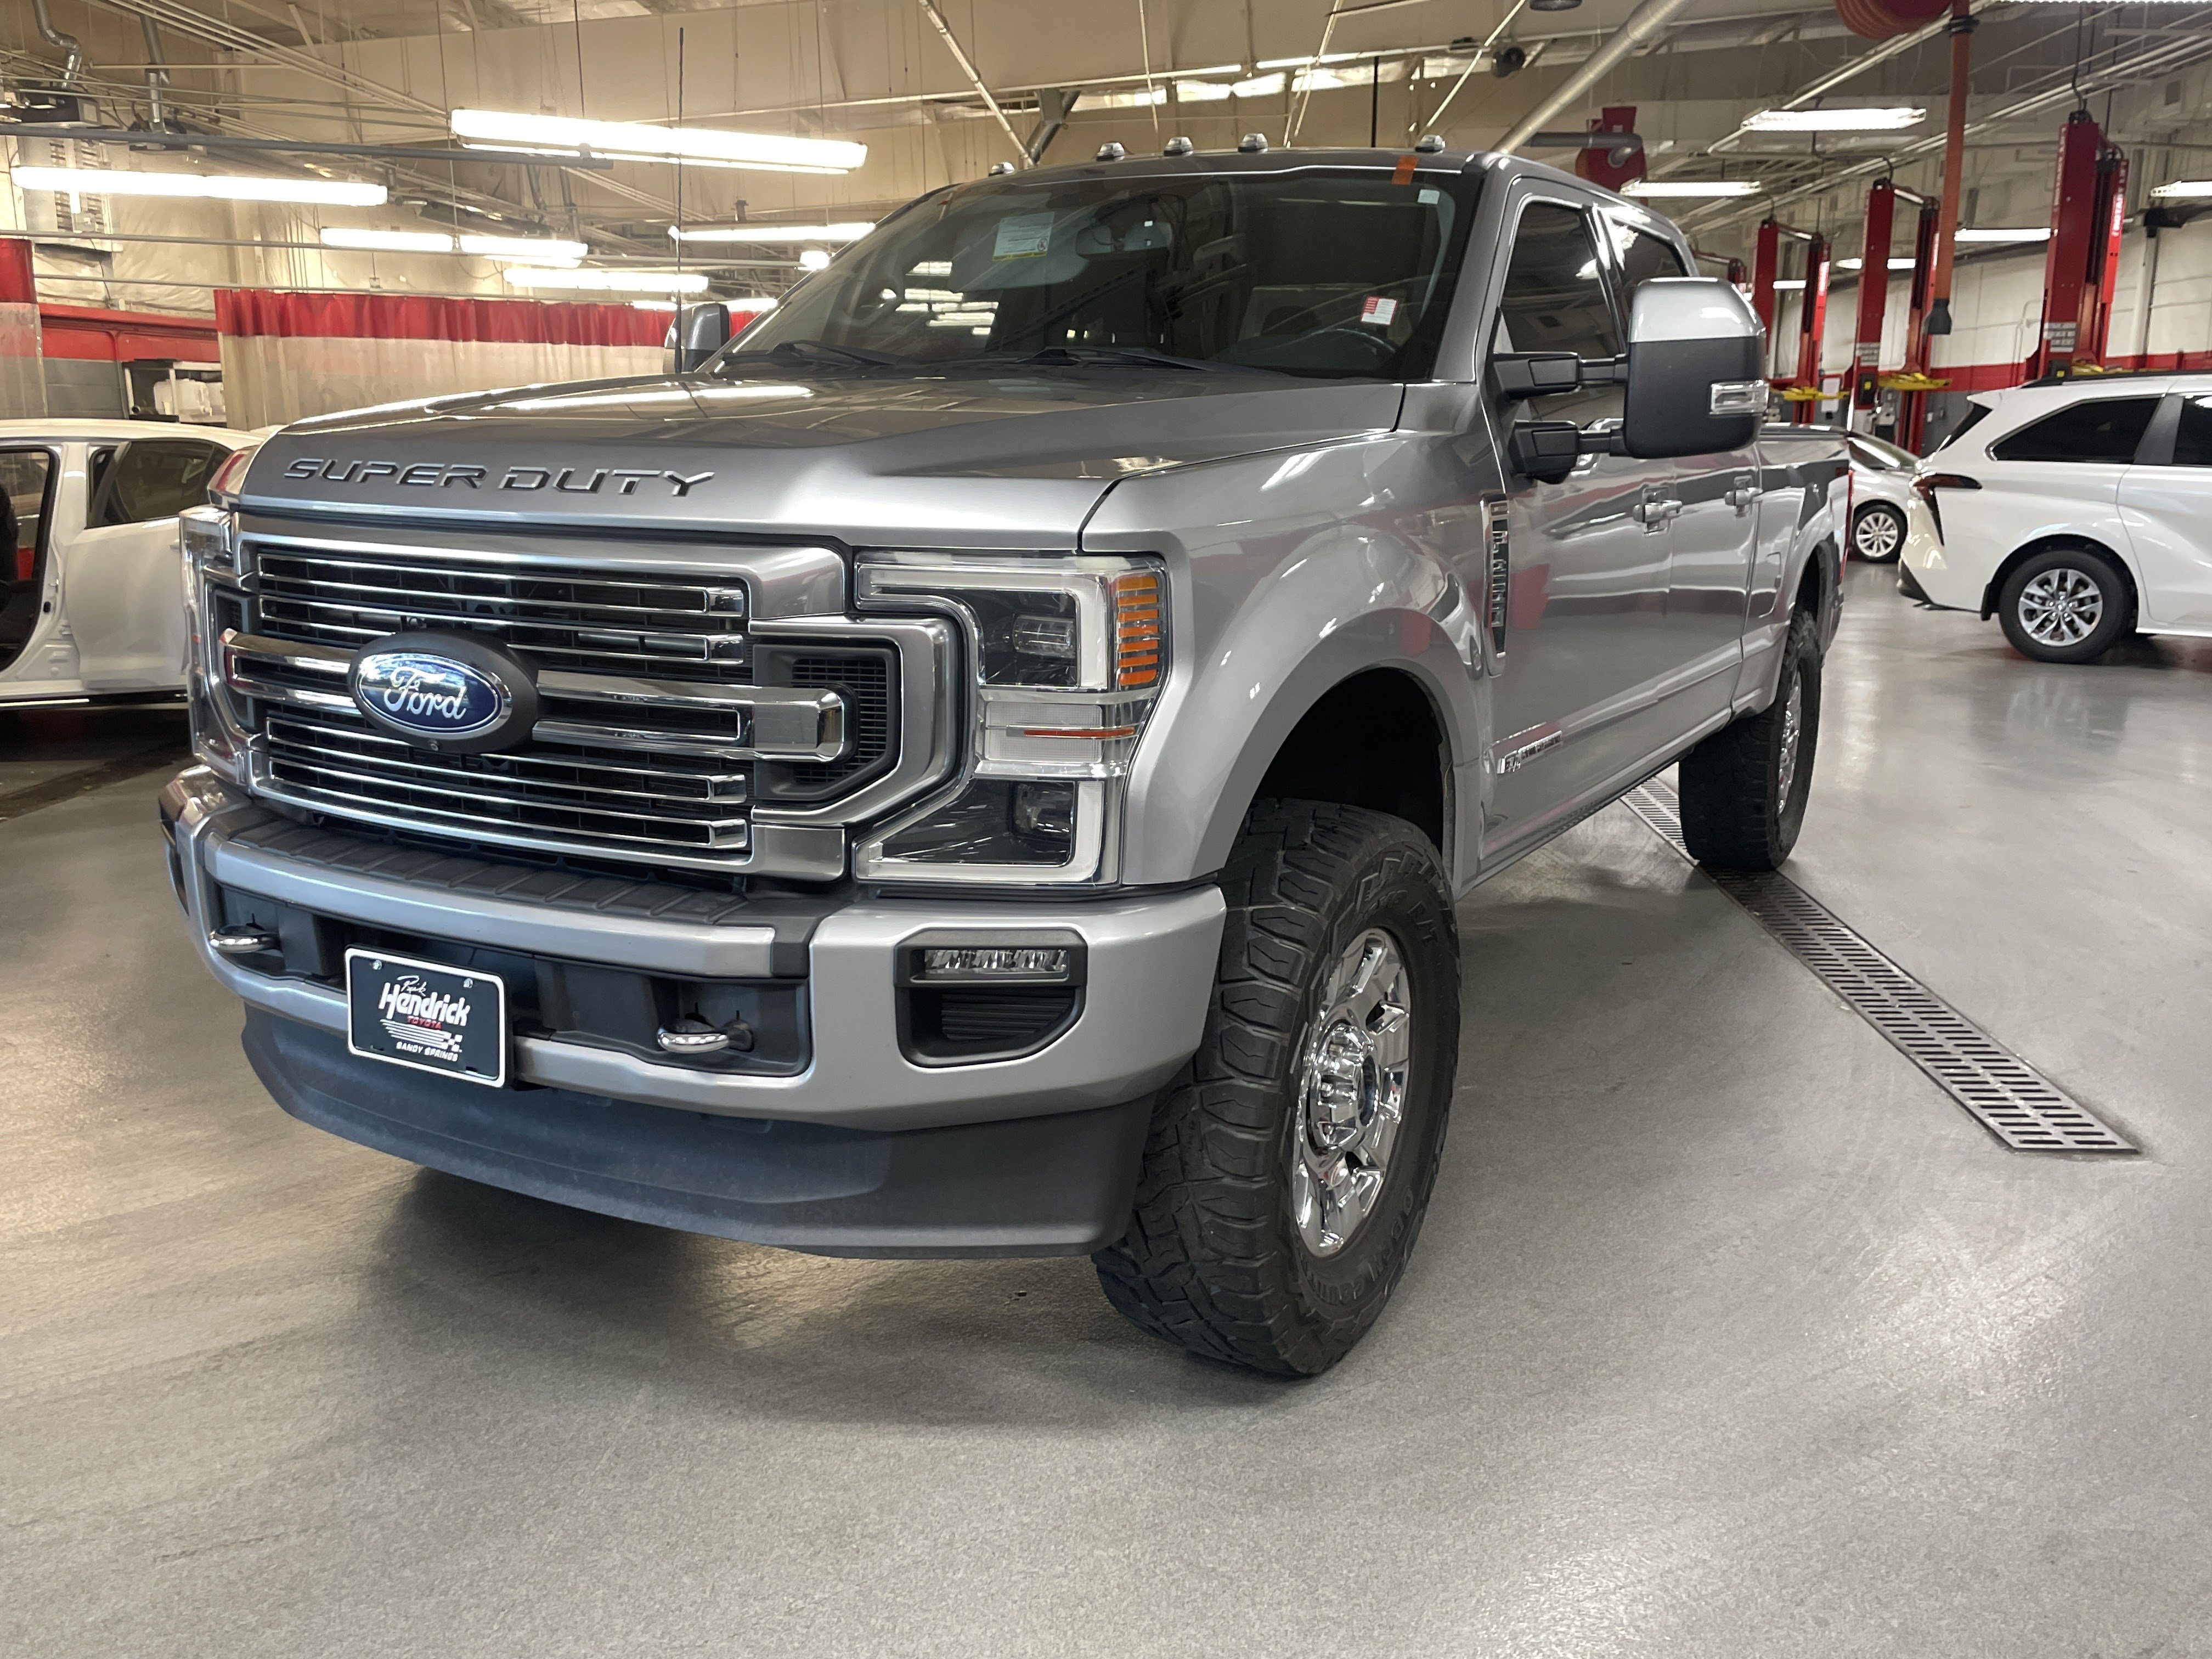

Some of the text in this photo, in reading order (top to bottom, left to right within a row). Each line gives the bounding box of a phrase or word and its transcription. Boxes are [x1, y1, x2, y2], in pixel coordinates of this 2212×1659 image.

[283, 458, 715, 497] SUPER DUTY
[384, 666, 467, 720] Ford
[378, 982, 471, 1026] Hendrick
[407, 1015, 442, 1030] TOYOTA
[396, 1041, 459, 1062] SANDY SPRINGS
